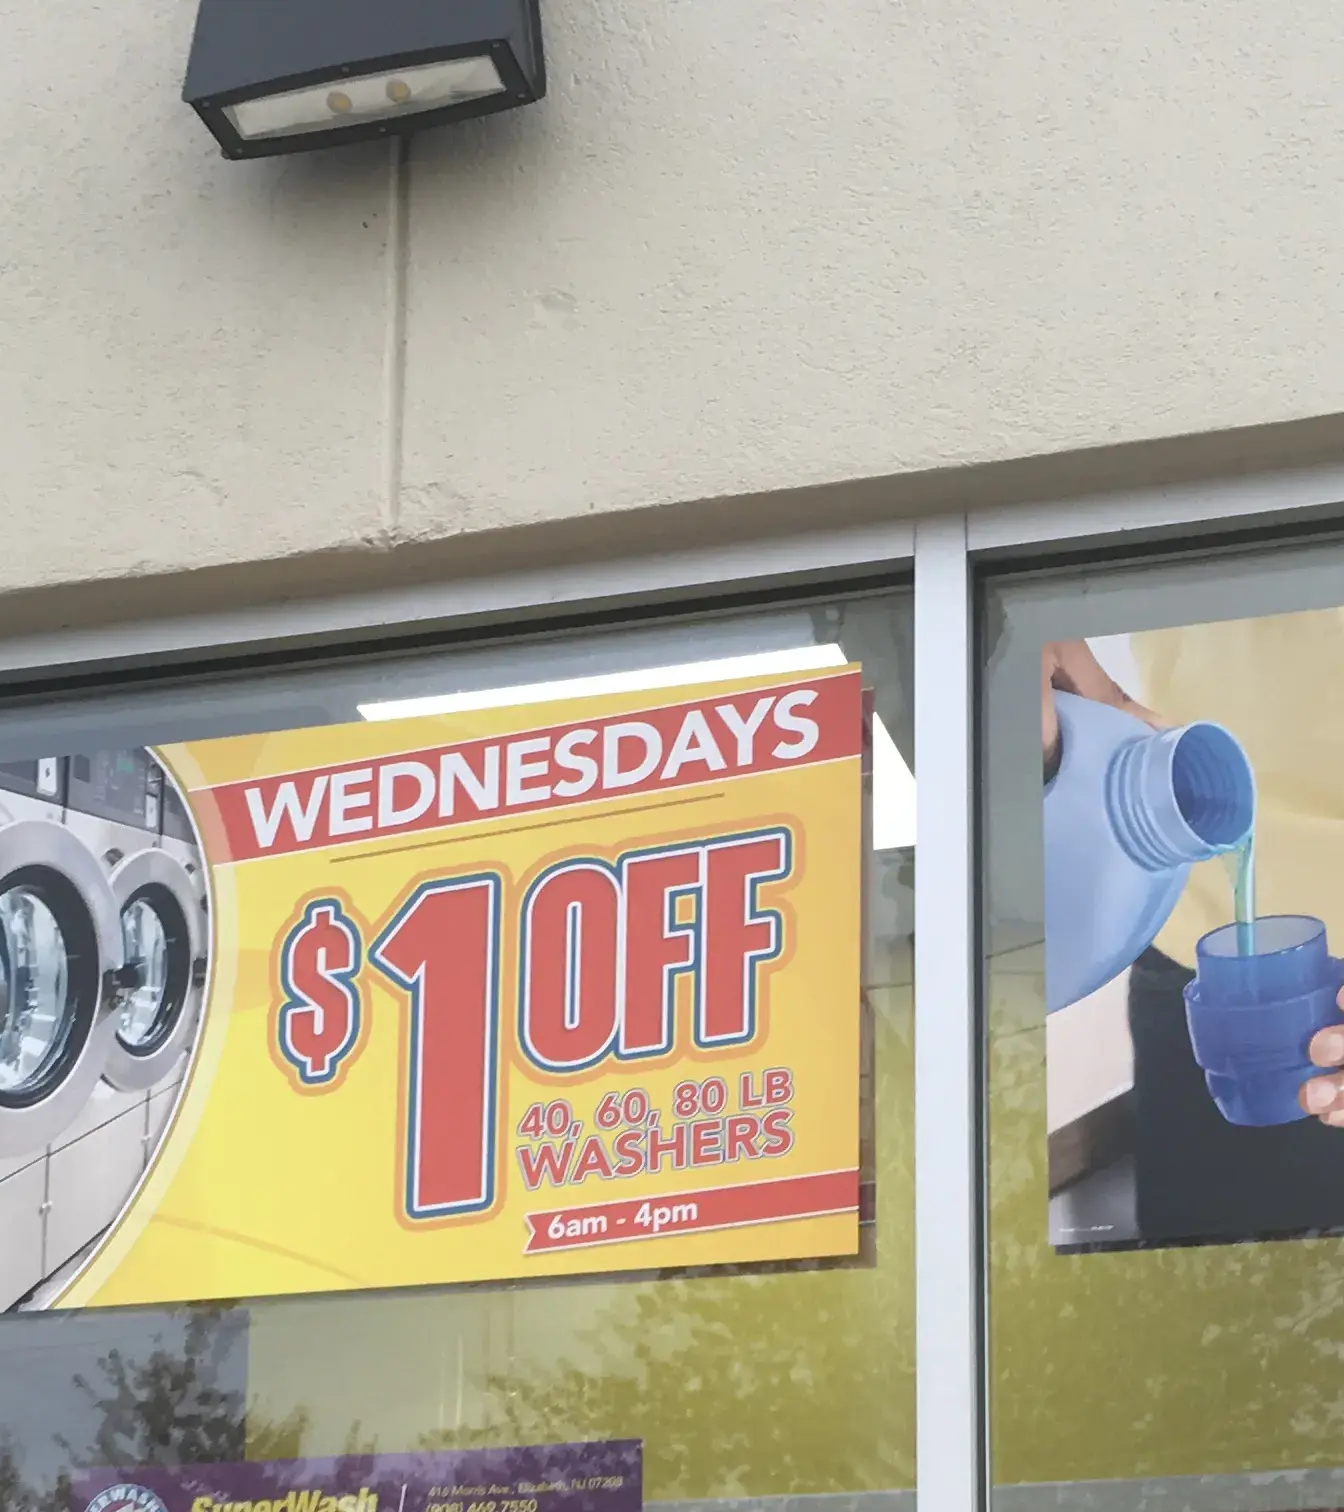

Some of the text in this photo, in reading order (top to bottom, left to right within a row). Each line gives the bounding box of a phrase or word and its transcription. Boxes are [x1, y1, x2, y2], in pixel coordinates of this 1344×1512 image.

[246, 690, 819, 849] WEDNESDAYS
[278, 826, 791, 1219] $1 OFF
[517, 1069, 793, 1140] 40, 60, 80 LB
[517, 1110, 794, 1190] WASHERS
[547, 1212, 608, 1240] 6am
[635, 1200, 699, 1230] 4pm
